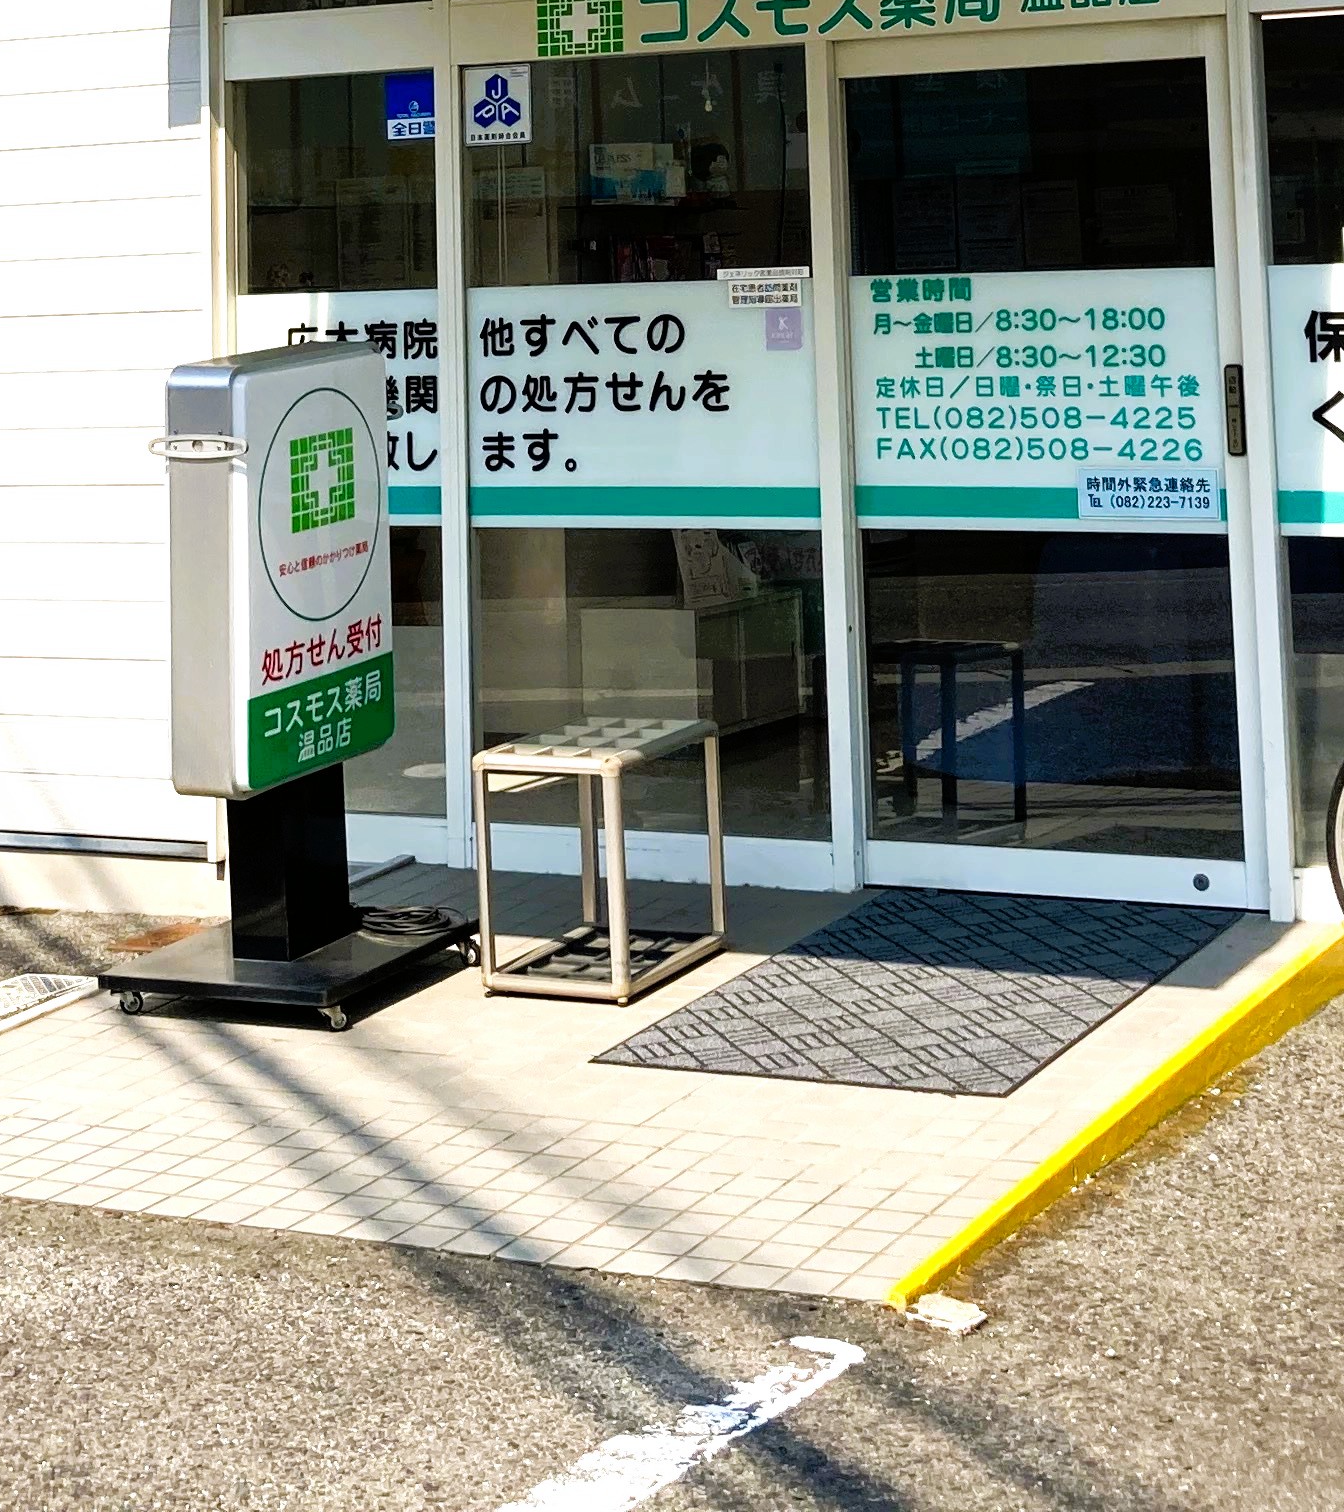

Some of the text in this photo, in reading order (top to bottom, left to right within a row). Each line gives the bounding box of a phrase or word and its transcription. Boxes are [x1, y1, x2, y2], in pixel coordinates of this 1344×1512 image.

[870, 277, 972, 302] 営業時間
[480, 313, 686, 356] 他すべての
[480, 370, 730, 414] の処方せんを
[1086, 477, 1211, 492] 時間外緊急連絡先
[1110, 494, 1210, 509] (082)223-7139
[261, 614, 383, 685] 処方せん受付
[264, 670, 382, 737] コスモス薬局
[297, 718, 352, 763] 温品店
